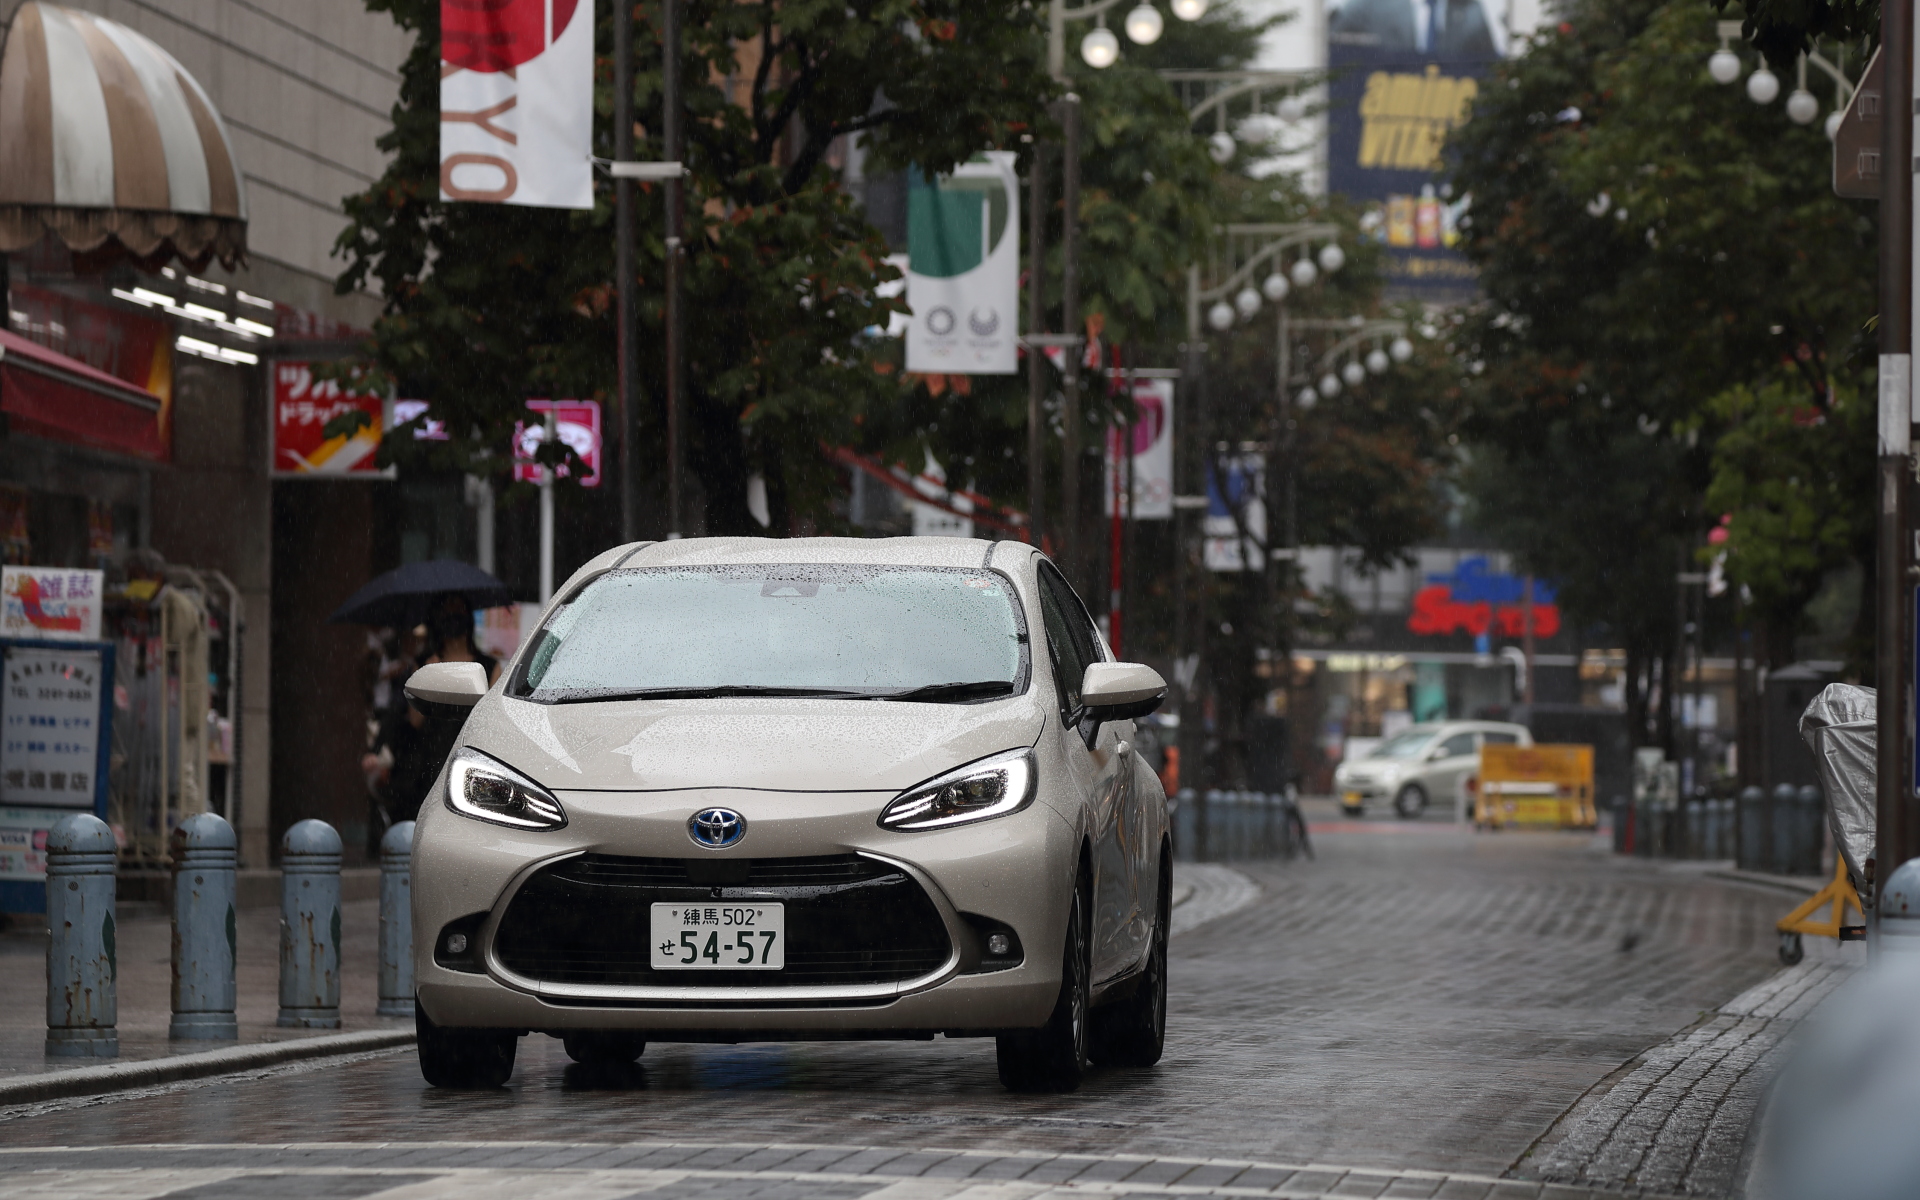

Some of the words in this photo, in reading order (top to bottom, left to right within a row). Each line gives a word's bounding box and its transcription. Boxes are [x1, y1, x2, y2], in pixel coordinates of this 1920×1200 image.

[683, 908, 719, 925] 練馬
[723, 908, 755, 925] 502
[659, 939, 676, 956] せ
[680, 930, 777, 964] 54-57
